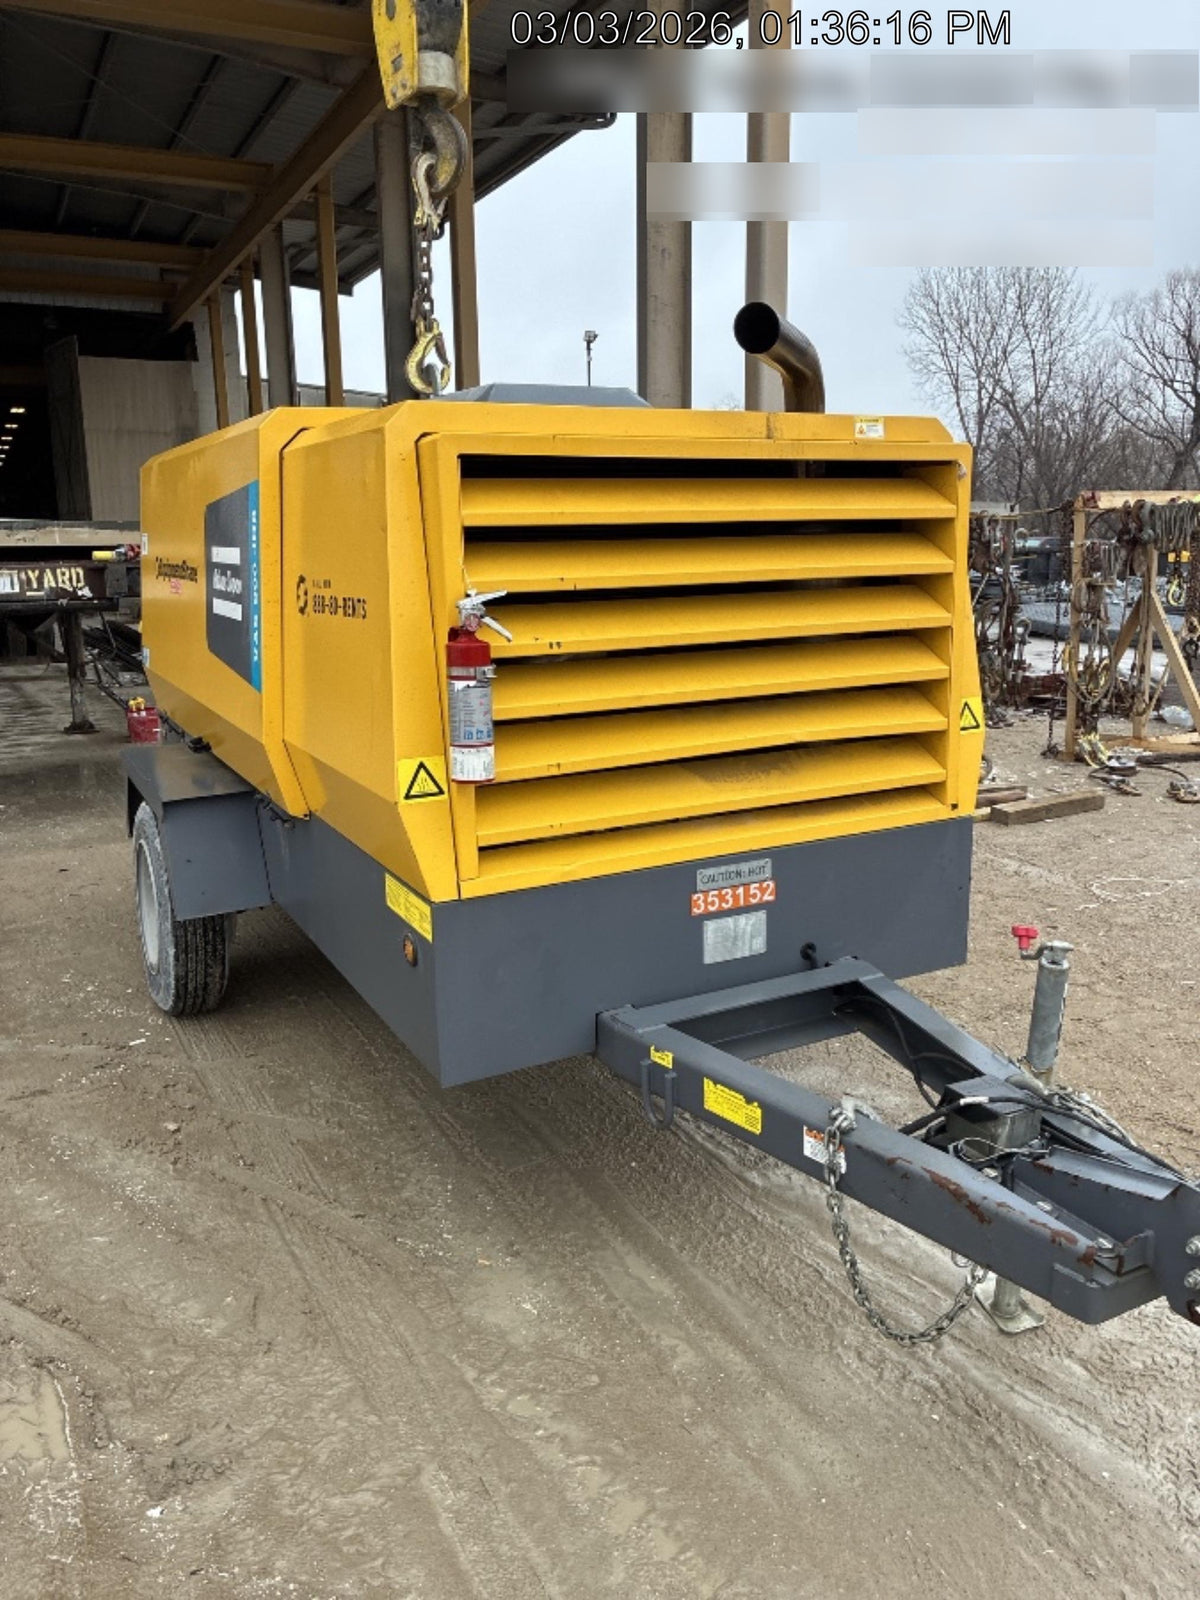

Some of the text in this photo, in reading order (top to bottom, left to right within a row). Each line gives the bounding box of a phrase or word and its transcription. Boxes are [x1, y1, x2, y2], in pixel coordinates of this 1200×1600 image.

[701, 865, 767, 884] CAUTION: HOT
[692, 881, 775, 913] 353152
